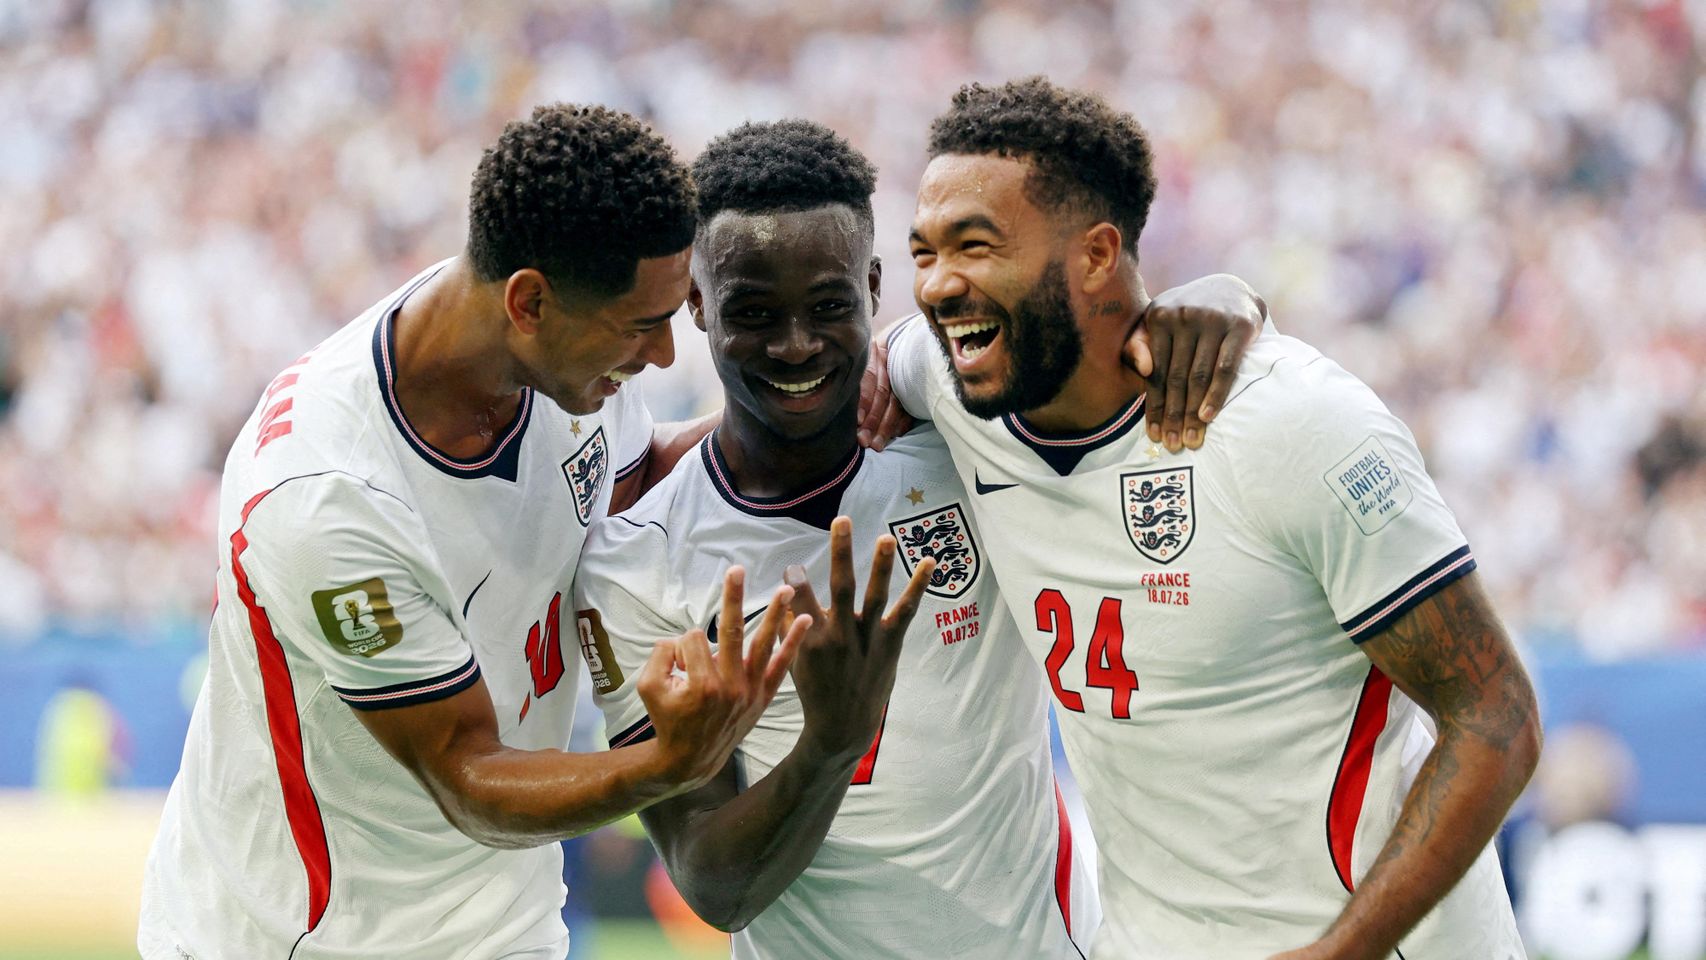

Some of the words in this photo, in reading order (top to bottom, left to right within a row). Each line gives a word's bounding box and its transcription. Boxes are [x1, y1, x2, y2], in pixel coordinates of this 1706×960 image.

[1339, 450, 1381, 487] FOOTBALL
[1347, 460, 1391, 501] UNITES
[1358, 500, 1376, 516] the
[1373, 473, 1400, 503] World
[1378, 499, 1396, 515] FIFA
[1141, 573, 1190, 588] FRANCE
[1147, 588, 1189, 606] 18.07.26
[935, 602, 979, 628] FRANCE
[941, 621, 979, 645] 18.07.26
[351, 638, 386, 655] 2026
[1034, 588, 1139, 719] 24
[594, 678, 611, 688] 026
